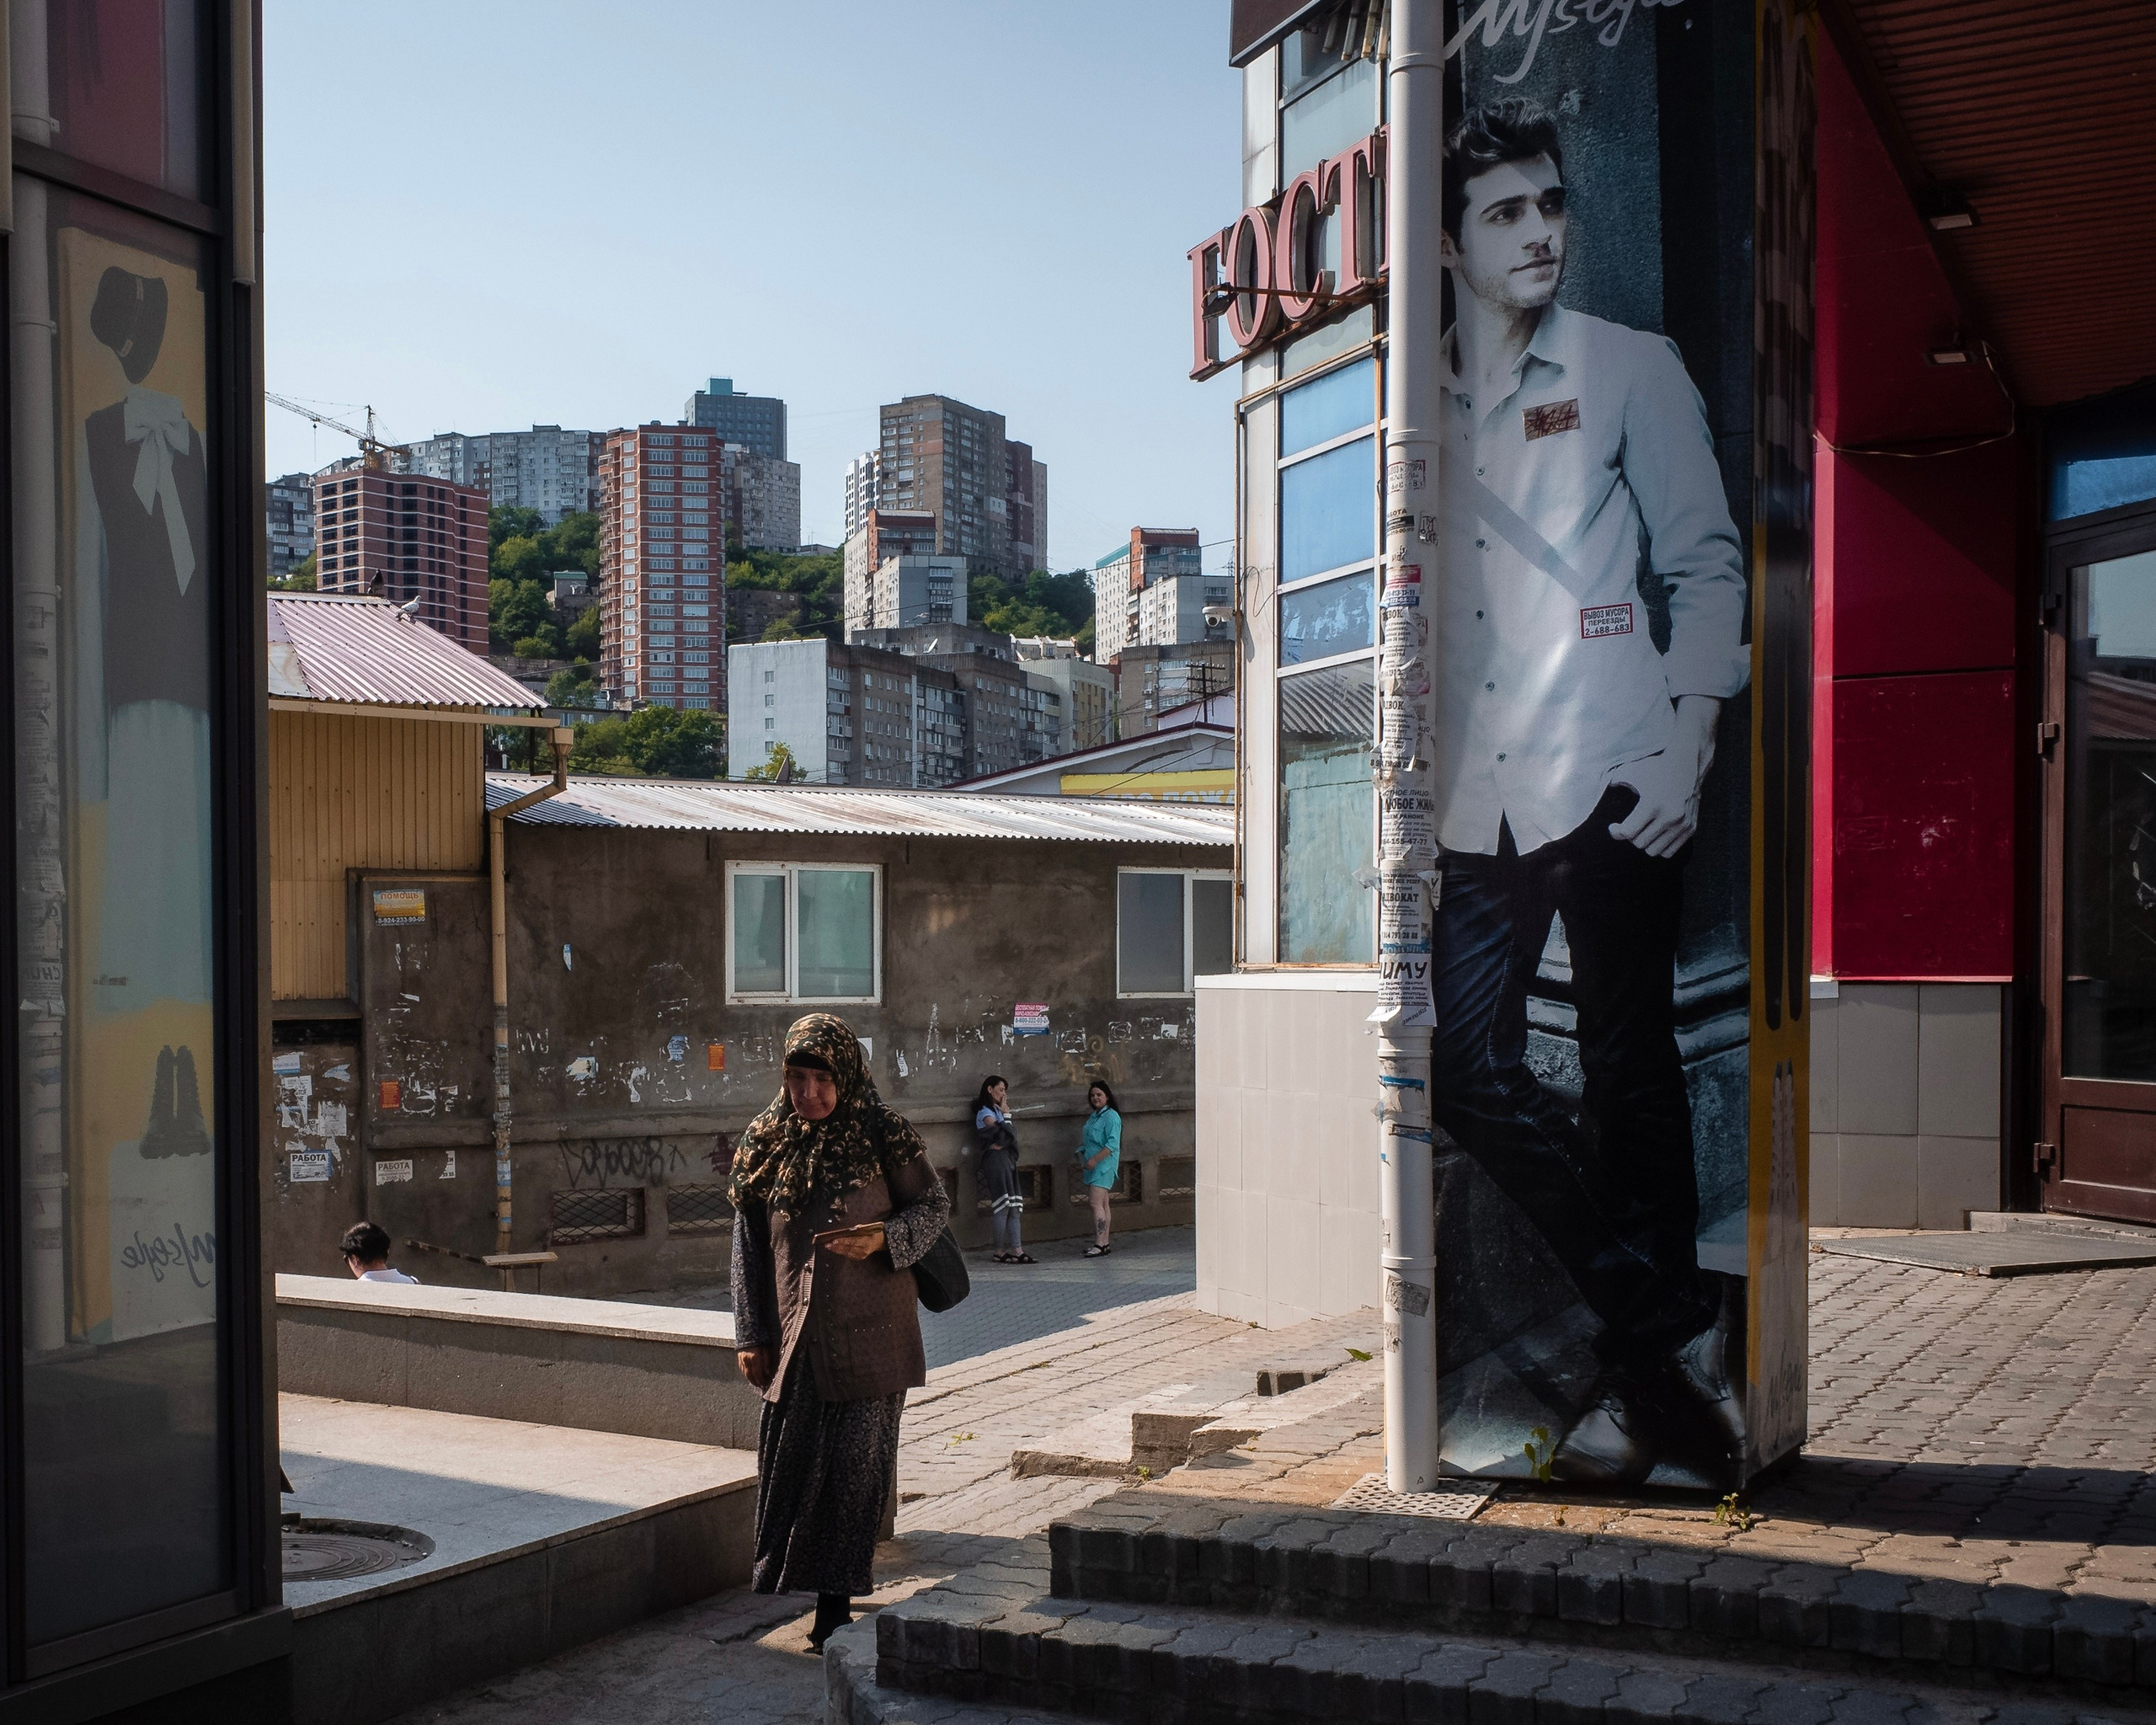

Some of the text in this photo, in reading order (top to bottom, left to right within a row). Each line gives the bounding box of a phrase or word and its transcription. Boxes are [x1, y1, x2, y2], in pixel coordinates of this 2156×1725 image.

[1187, 123, 1390, 382] ГОСТ
[1584, 607, 1629, 620] ВЫВОЗ МУСОРА
[1588, 617, 1625, 626] ПЕРЕЕЗДЫ
[1585, 623, 1630, 636] 2-688-683
